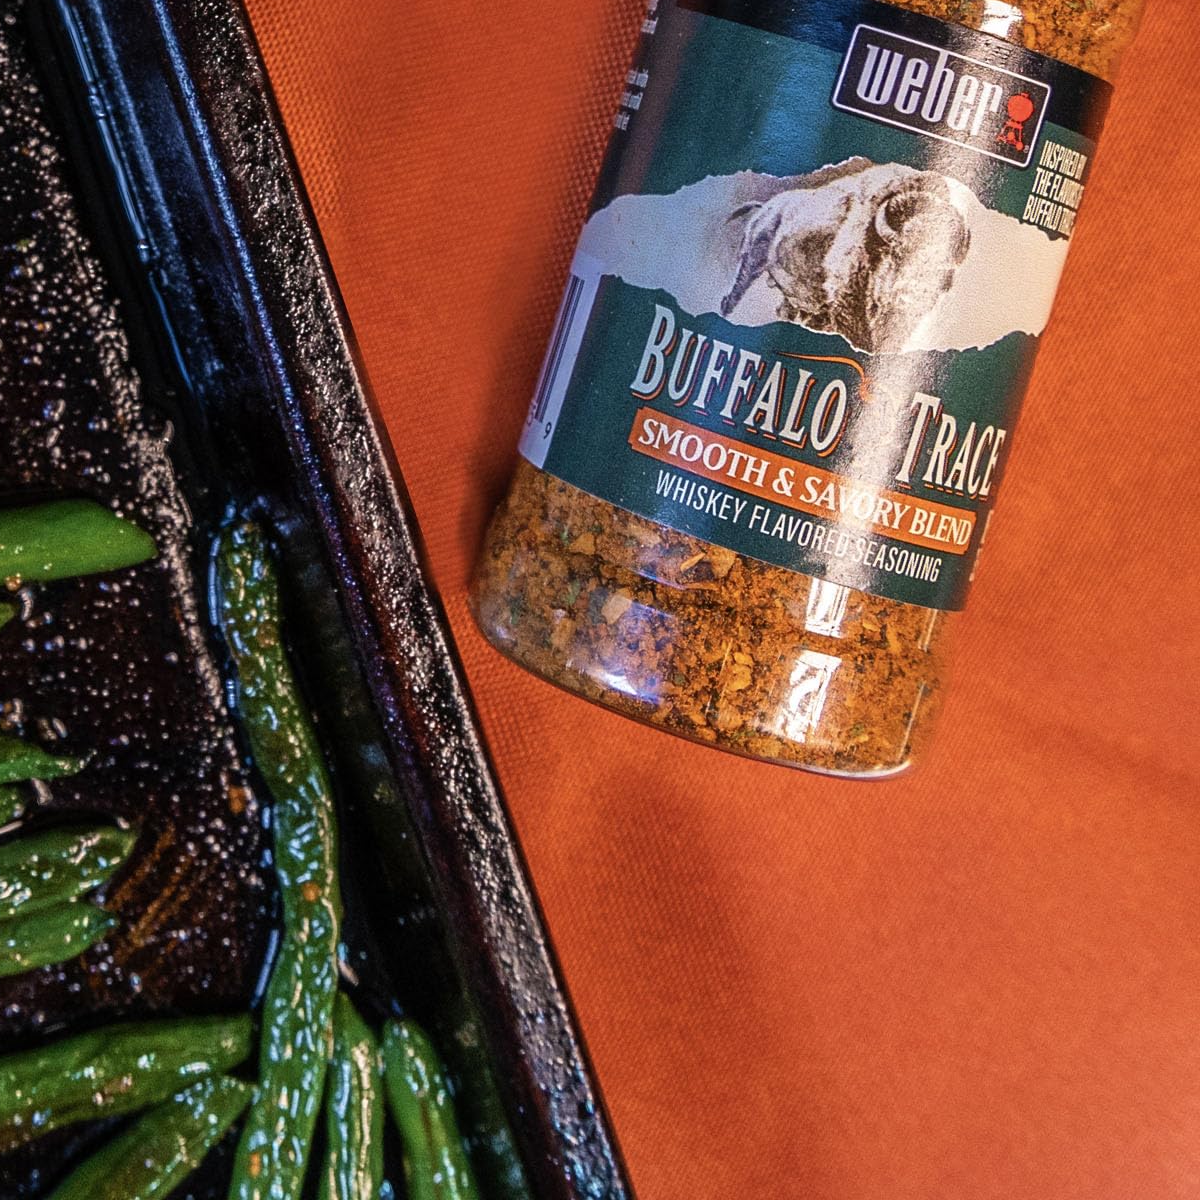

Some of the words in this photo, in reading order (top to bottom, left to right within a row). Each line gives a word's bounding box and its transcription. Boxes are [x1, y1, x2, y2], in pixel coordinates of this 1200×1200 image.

[856, 44, 1003, 136] weber
[1031, 167, 1054, 196] THE
[1039, 140, 1080, 177] INSPIRED
[1022, 194, 1063, 231] BUFFALO
[630, 303, 848, 455] BUFFALO
[896, 391, 1007, 498] TRACE
[638, 418, 771, 487] SMOOTH
[772, 467, 795, 497] &
[800, 476, 911, 530] SAVORY
[909, 507, 973, 546] BLEND
[655, 469, 748, 524] WHISKEY
[749, 505, 850, 558] FLAVORED
[852, 537, 942, 583] SEASONING
